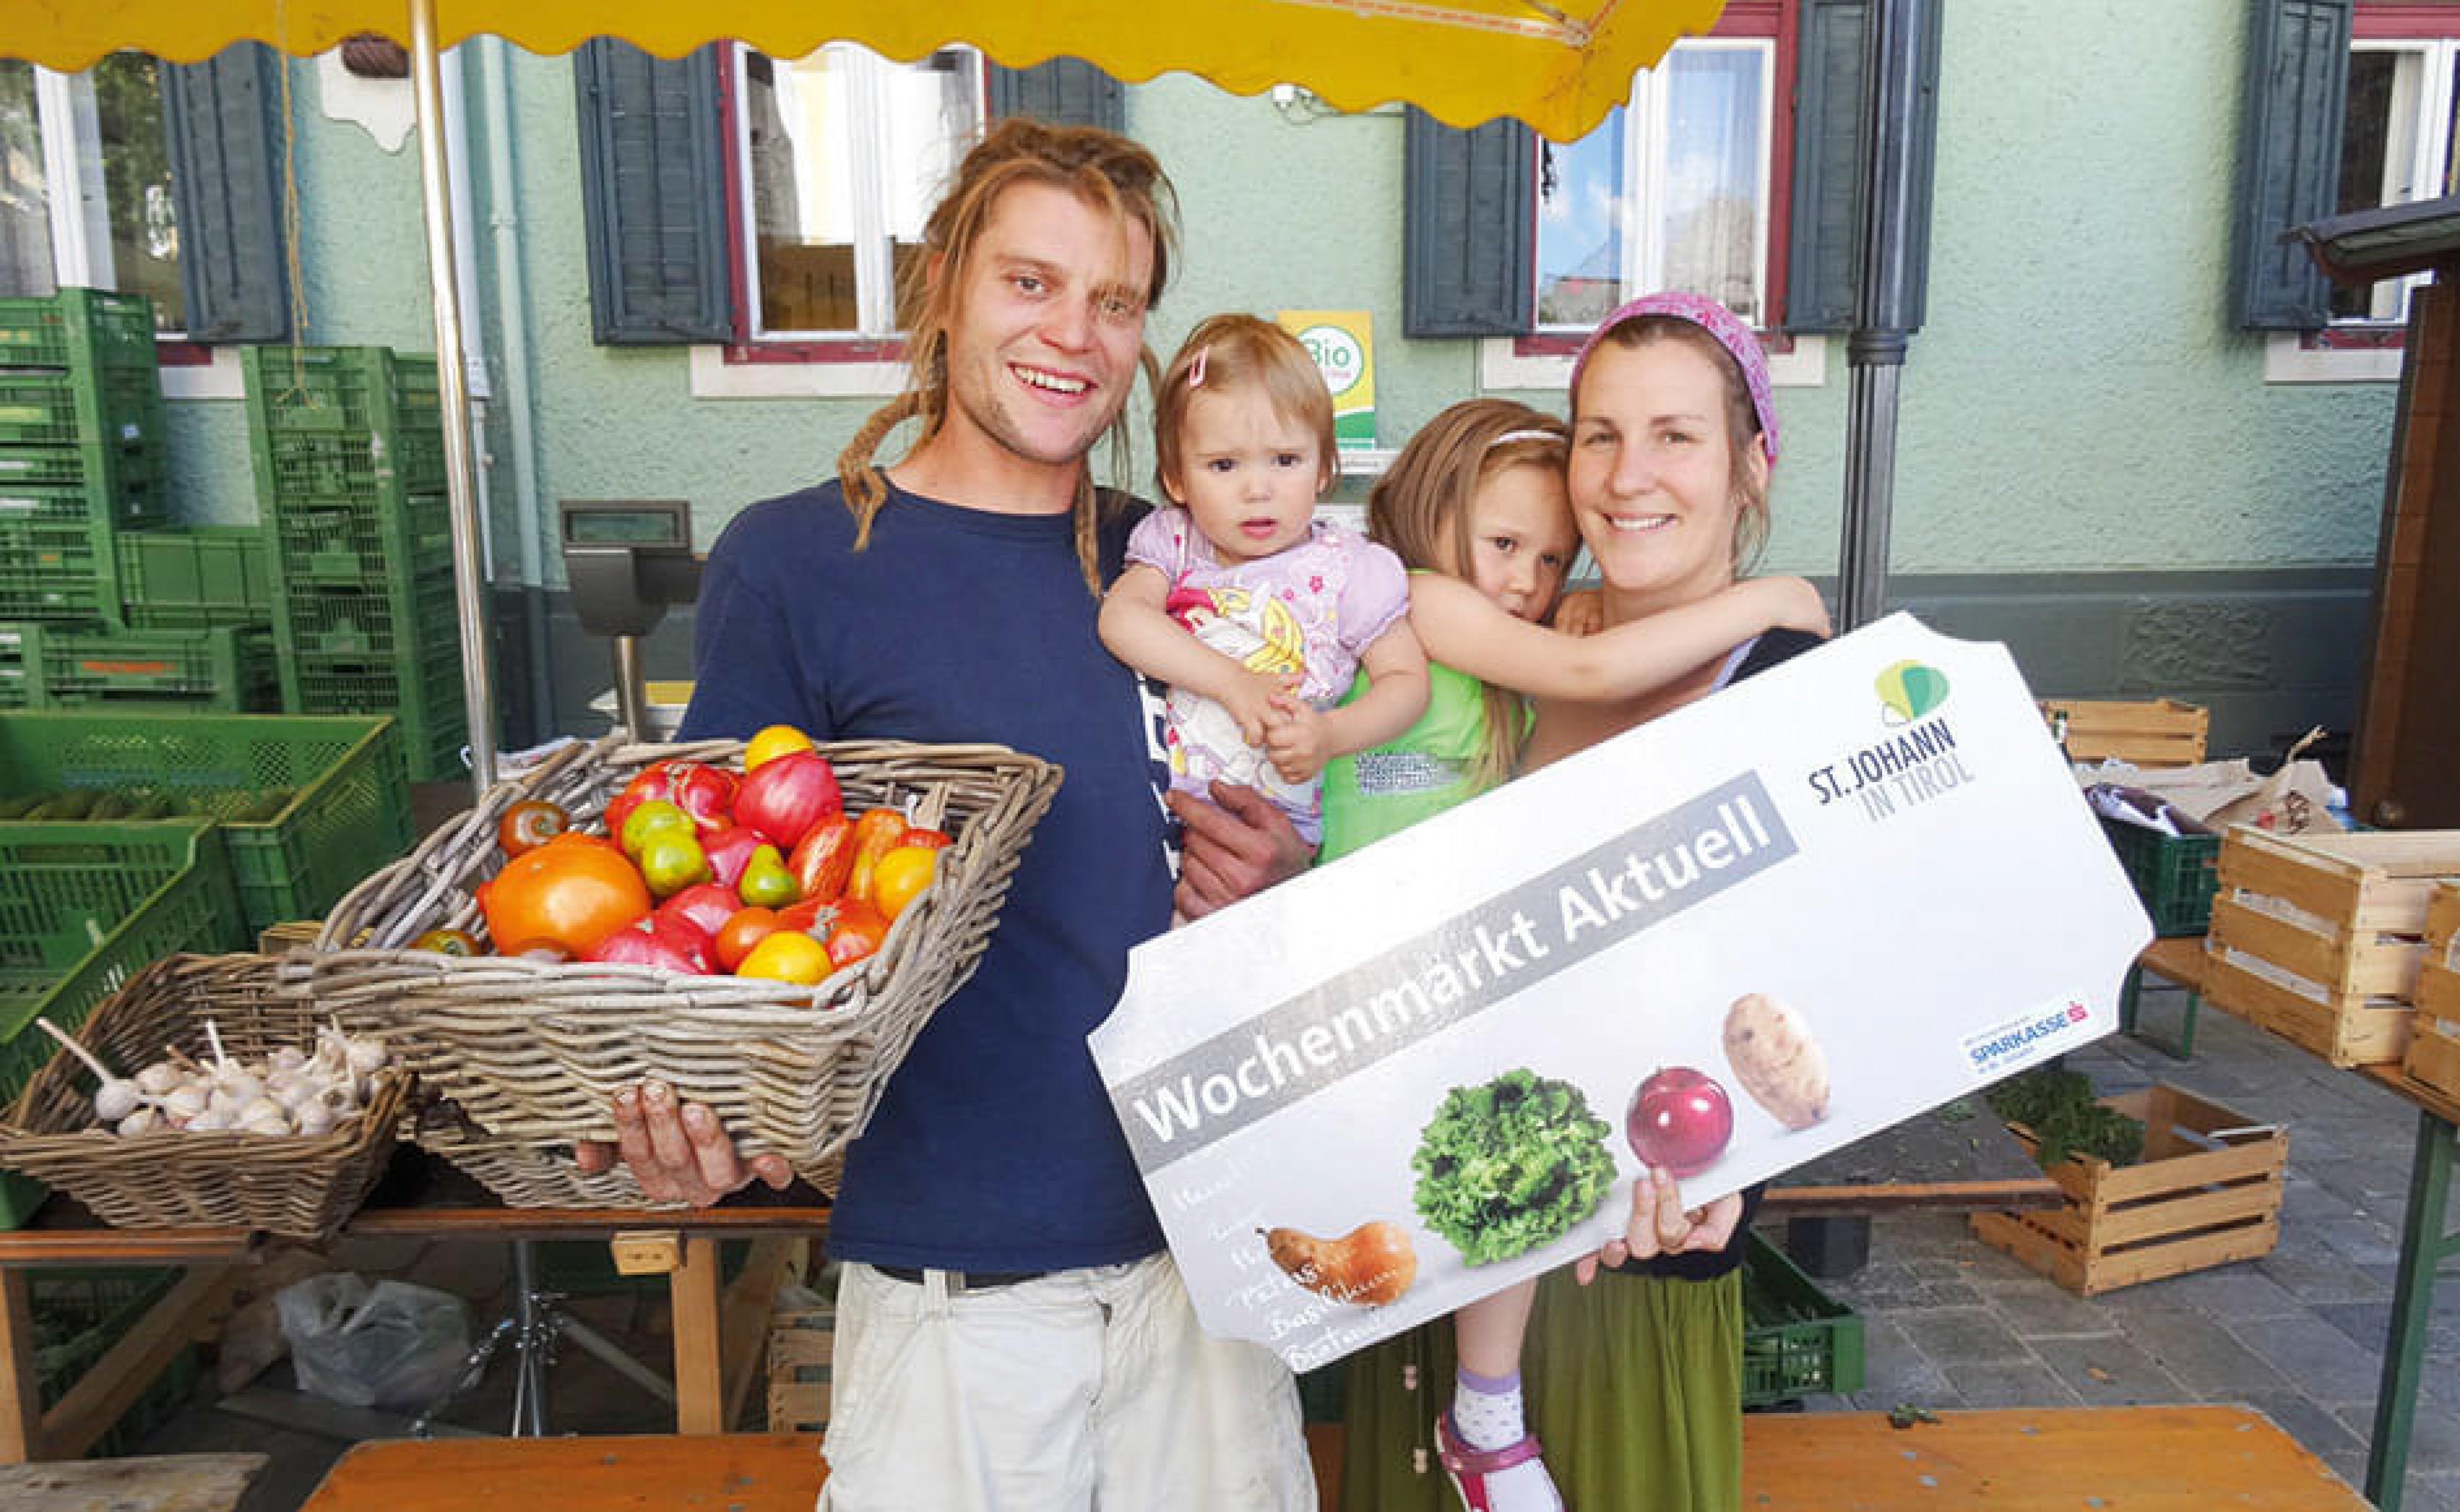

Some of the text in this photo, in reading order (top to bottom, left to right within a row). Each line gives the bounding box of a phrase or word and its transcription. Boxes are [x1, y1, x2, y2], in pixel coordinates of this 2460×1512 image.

[1808, 717, 1956, 806] ST. JOHANN
[1859, 753, 1975, 822] IN TIROL
[1136, 794, 1770, 1143] Wochenmarkt Aktuell
[1969, 1011, 2070, 1065] SPARKASSE
